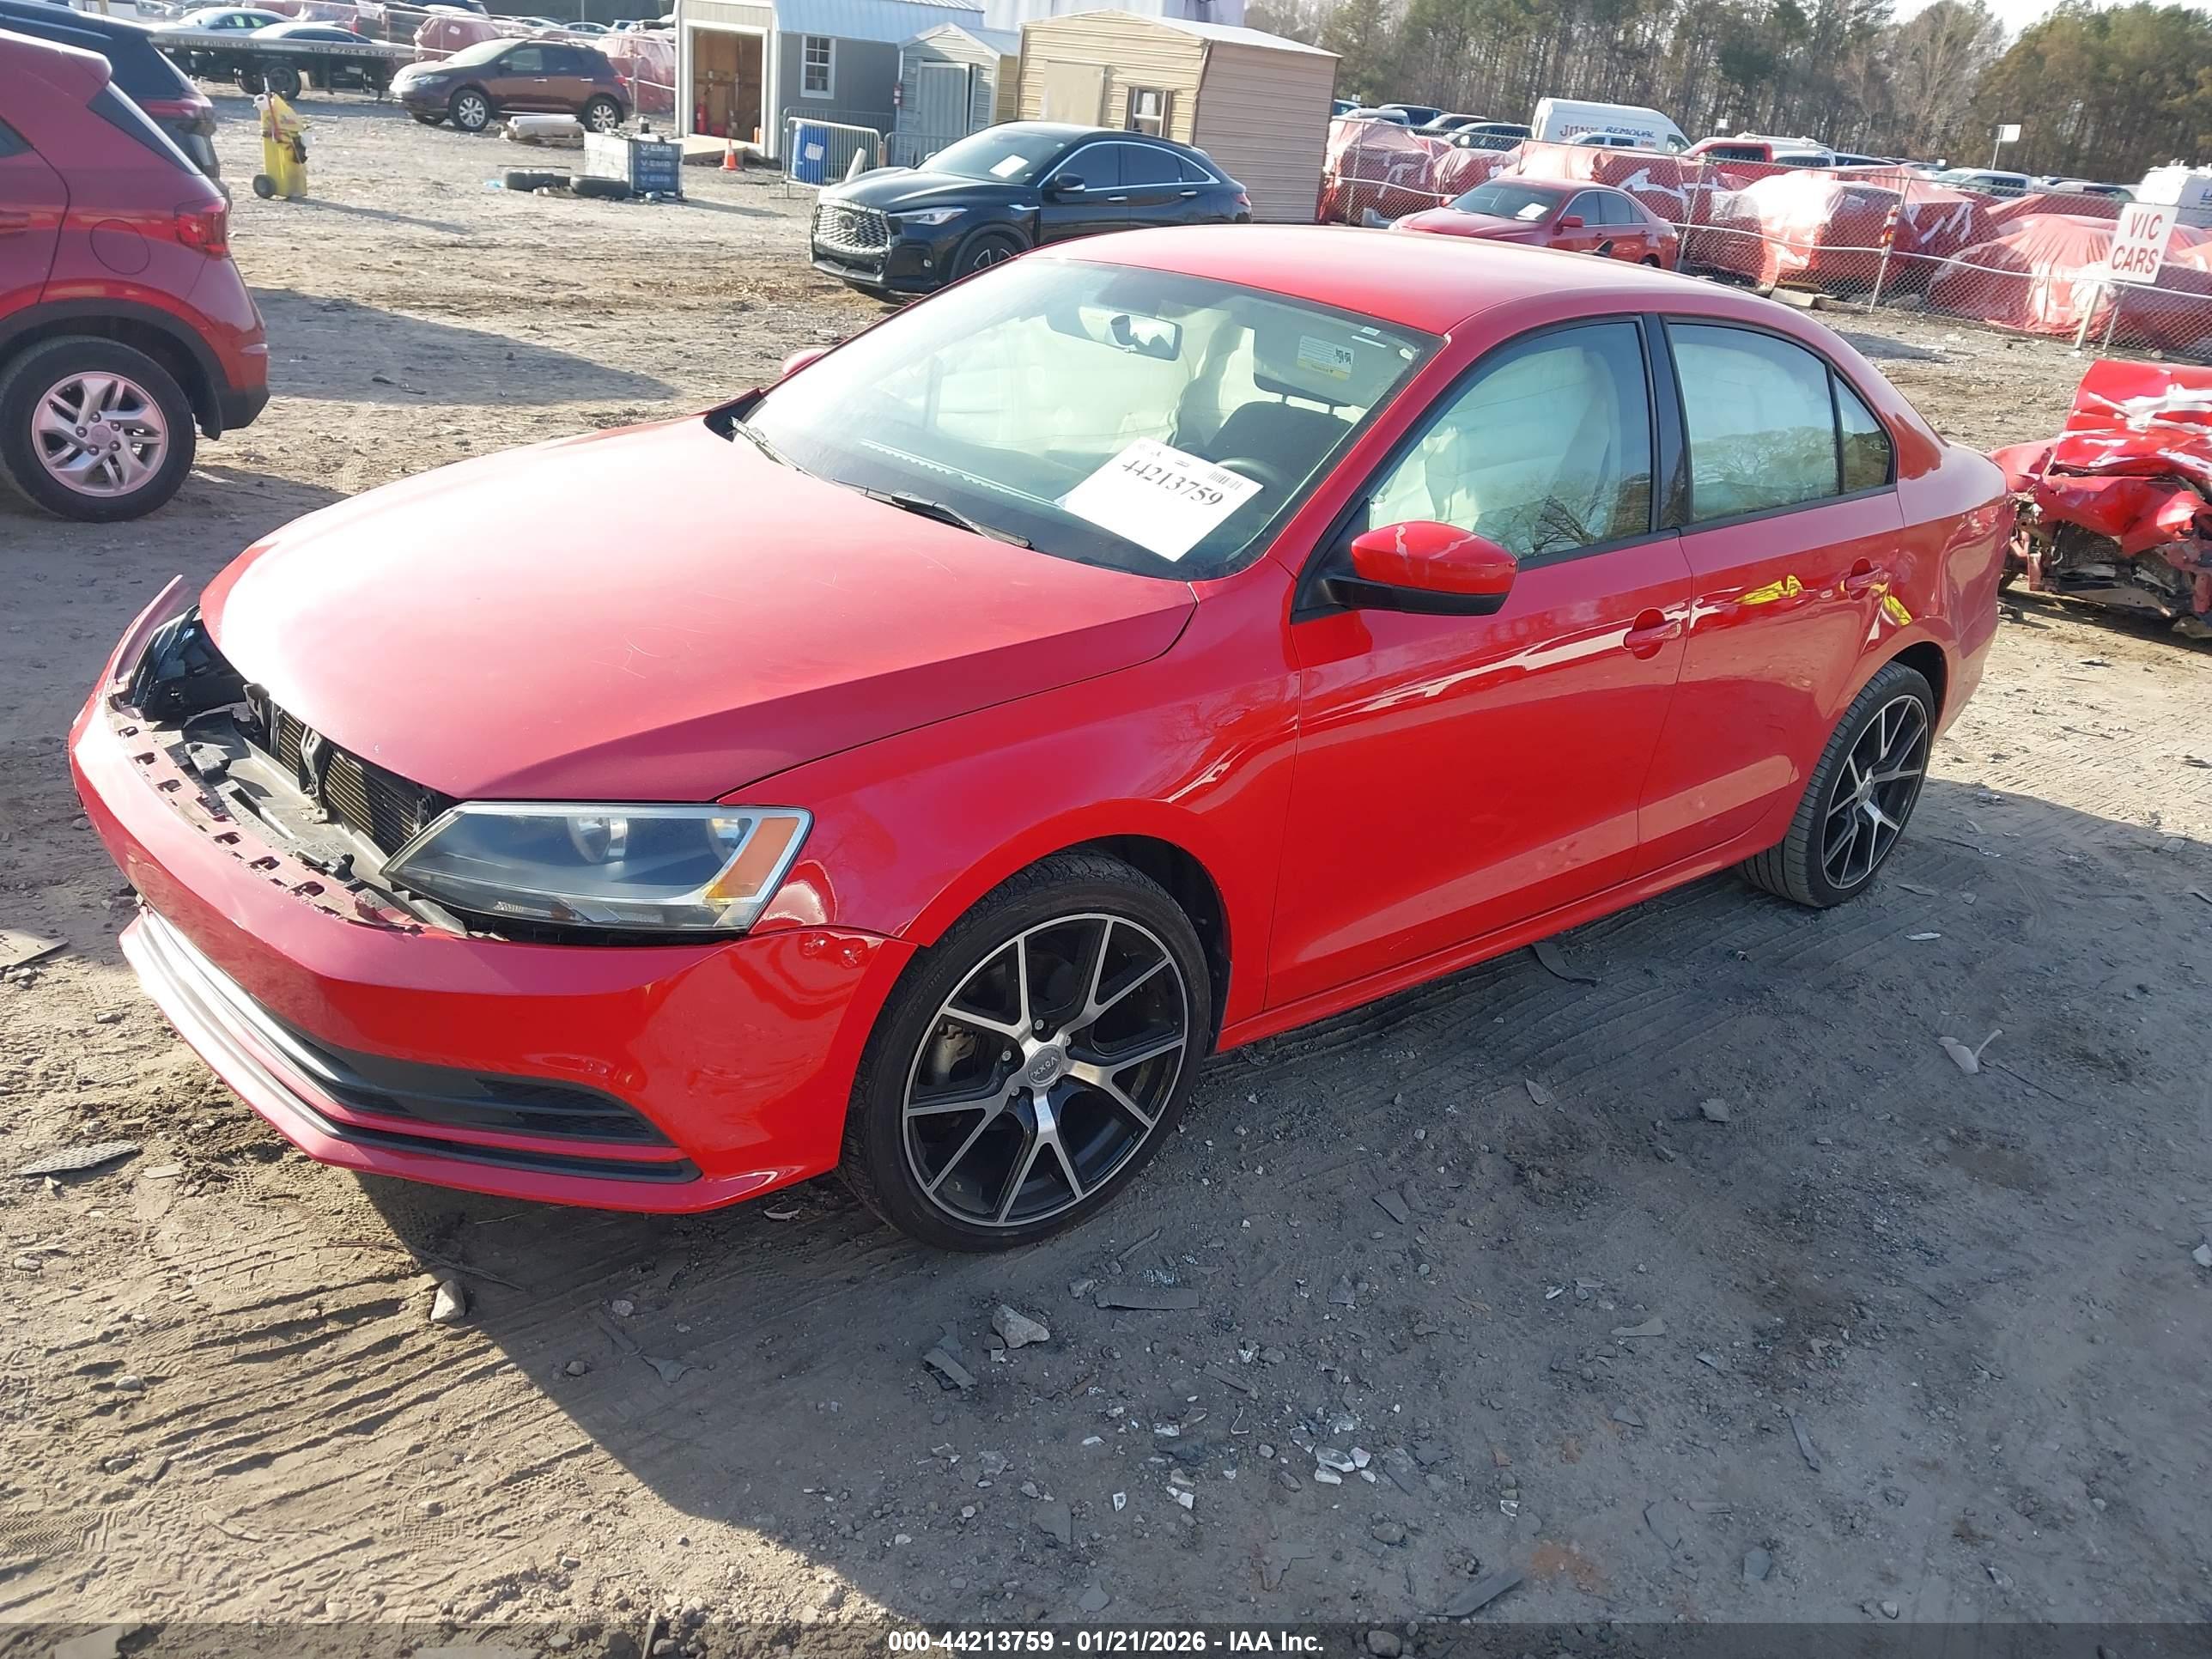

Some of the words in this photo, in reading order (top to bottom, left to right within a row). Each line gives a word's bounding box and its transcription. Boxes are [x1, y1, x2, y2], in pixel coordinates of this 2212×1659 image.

[2130, 212, 2163, 240] VIC
[2112, 245, 2159, 274] CARS
[1121, 459, 1224, 506] 44213759
